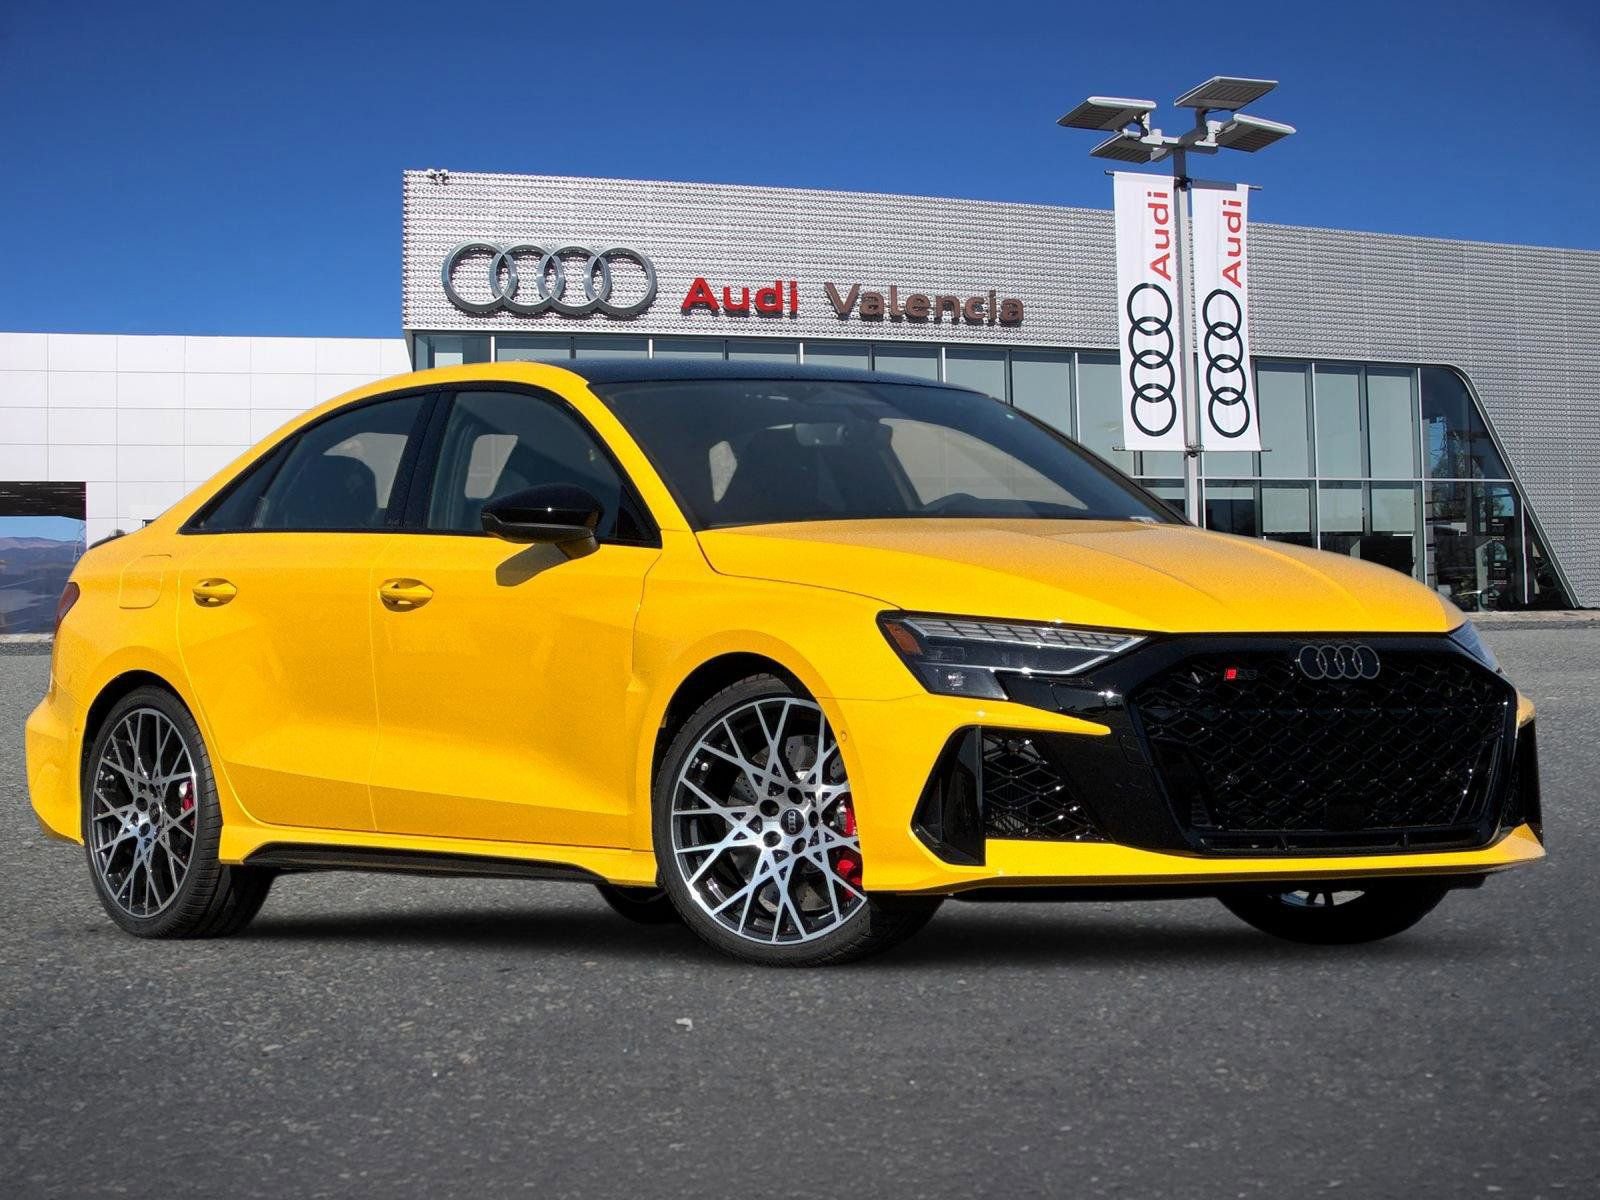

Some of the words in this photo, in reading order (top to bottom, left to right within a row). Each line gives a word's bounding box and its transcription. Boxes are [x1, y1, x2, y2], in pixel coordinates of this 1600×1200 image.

[1147, 191, 1172, 282] Audi
[1222, 199, 1243, 288] Audi
[681, 277, 800, 314] Audi
[824, 282, 1024, 325] Valencia
